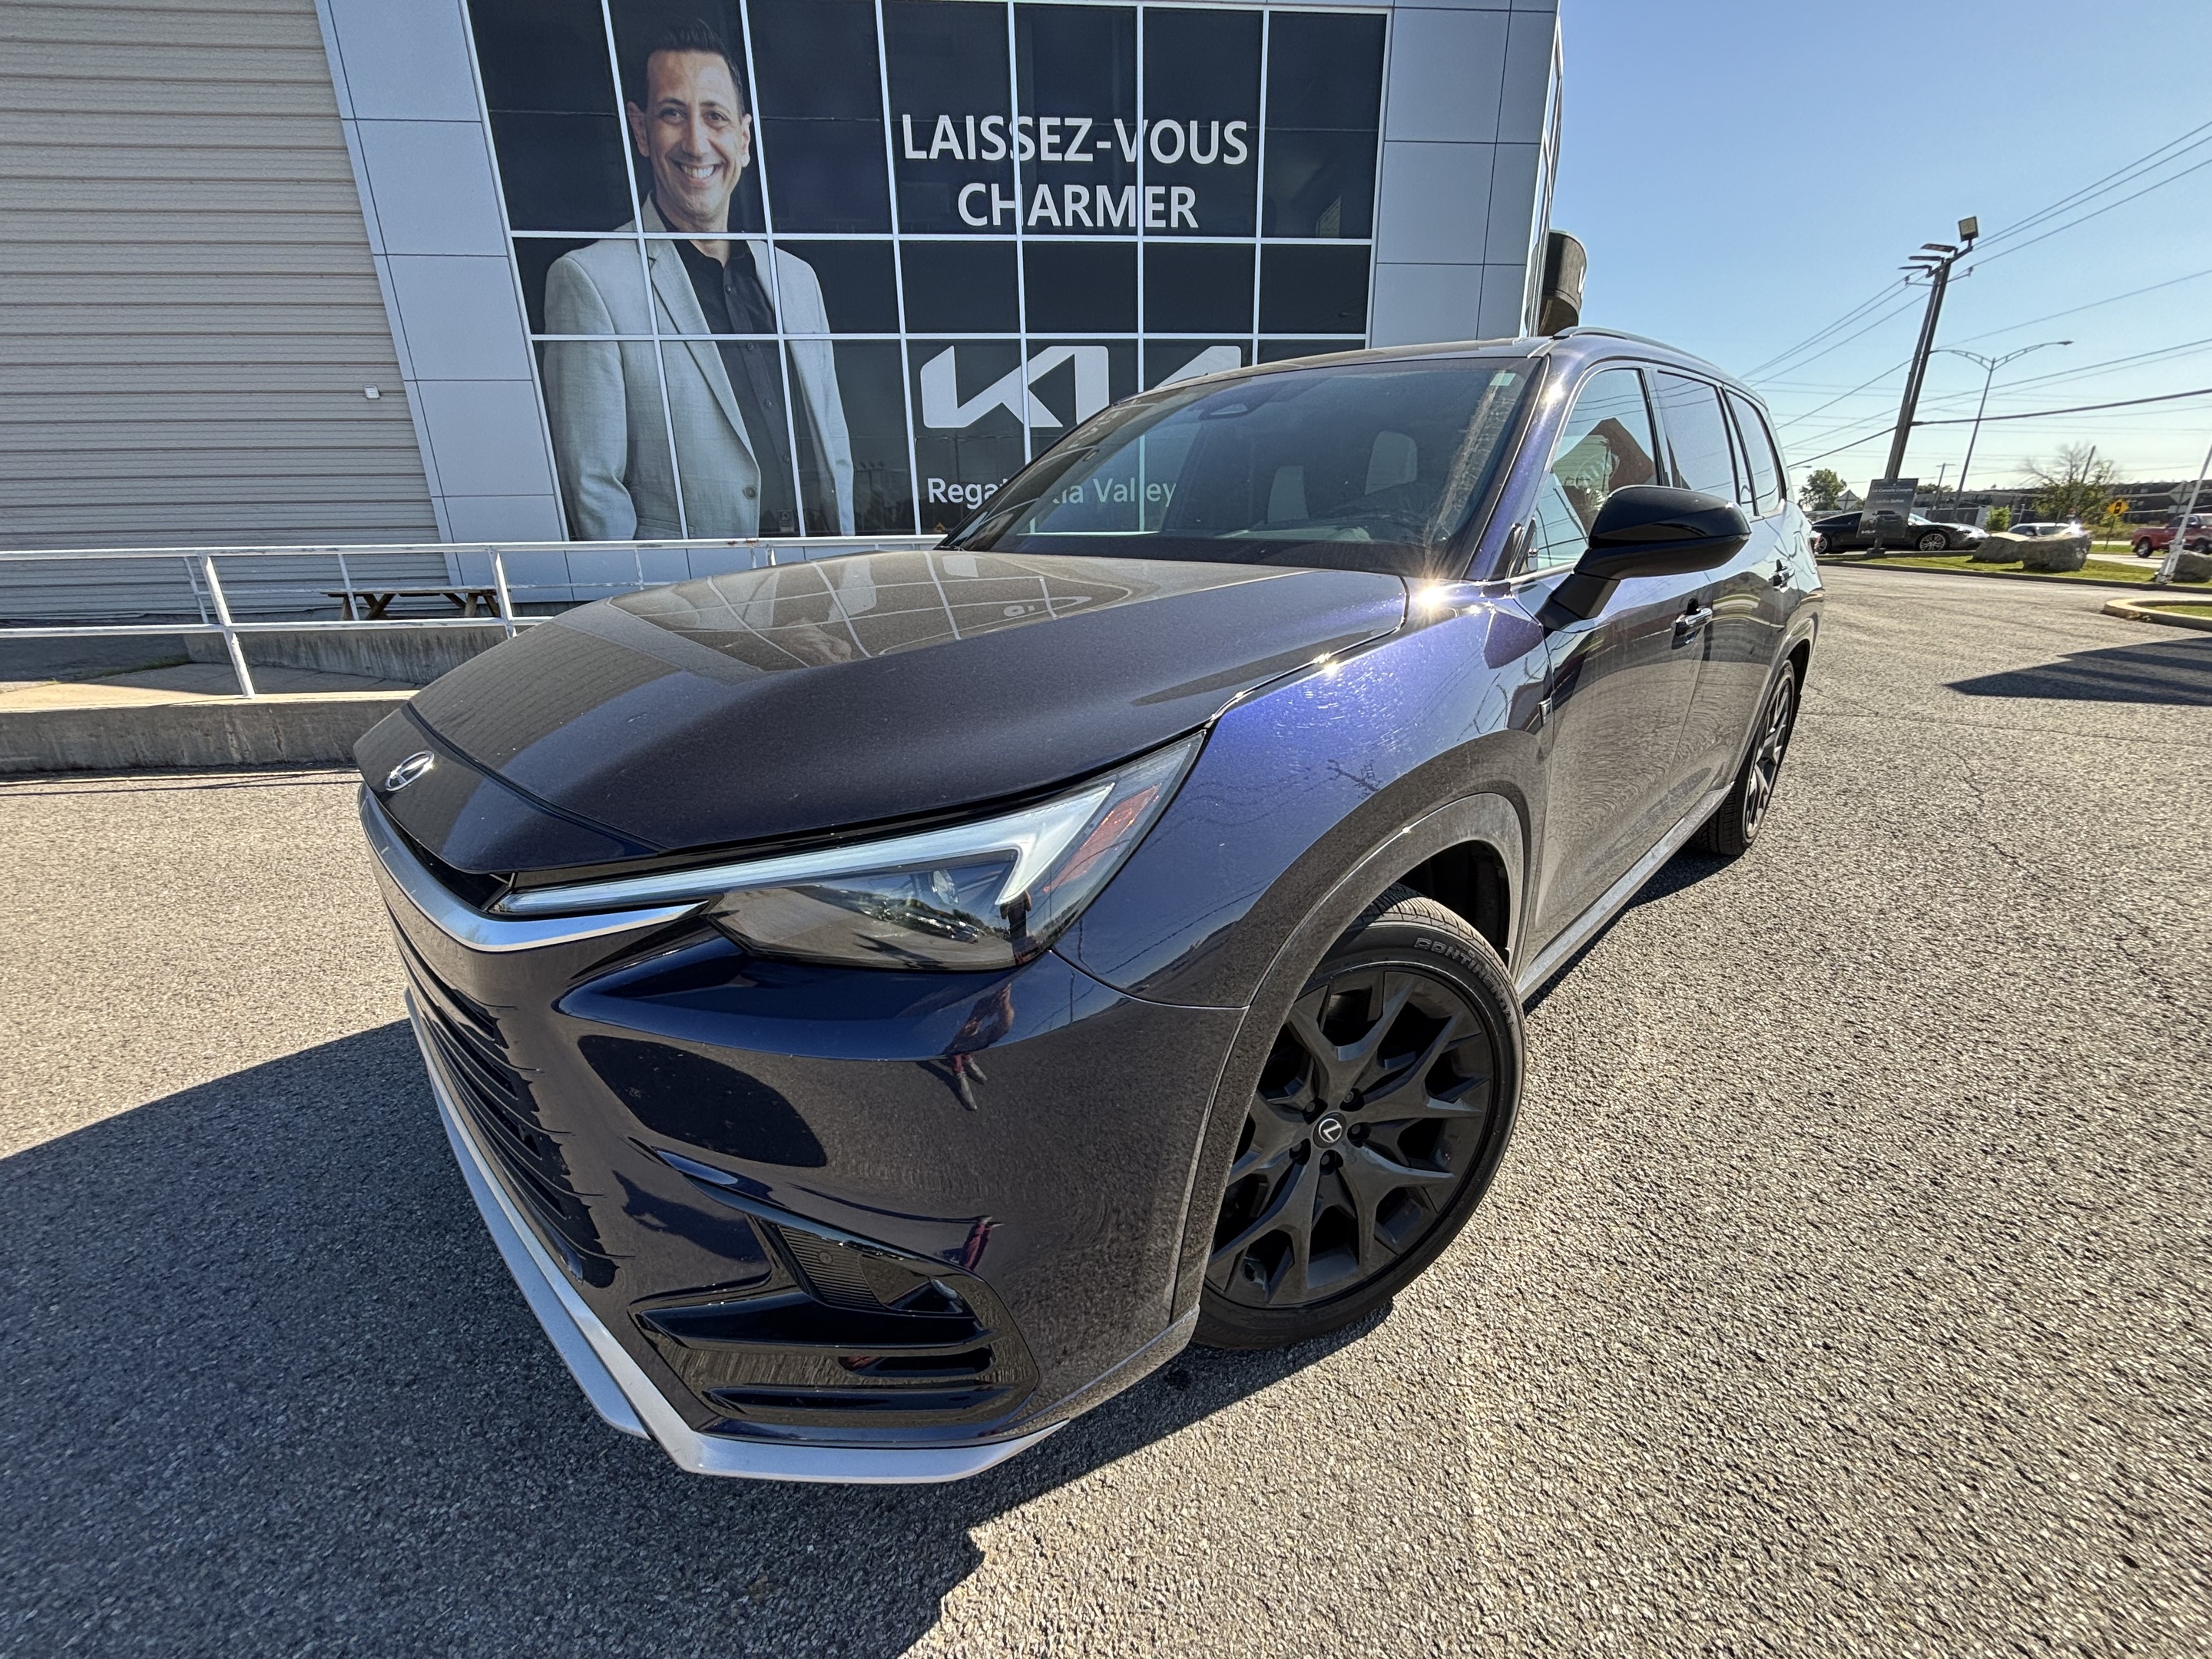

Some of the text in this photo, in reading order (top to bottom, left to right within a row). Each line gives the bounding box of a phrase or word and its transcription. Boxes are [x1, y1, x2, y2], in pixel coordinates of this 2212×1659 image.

[902, 114, 1248, 165] LAISSEZ-VOUS
[958, 182, 1200, 229] CHARMER
[1414, 937, 1514, 1028] CONTINENTAL
